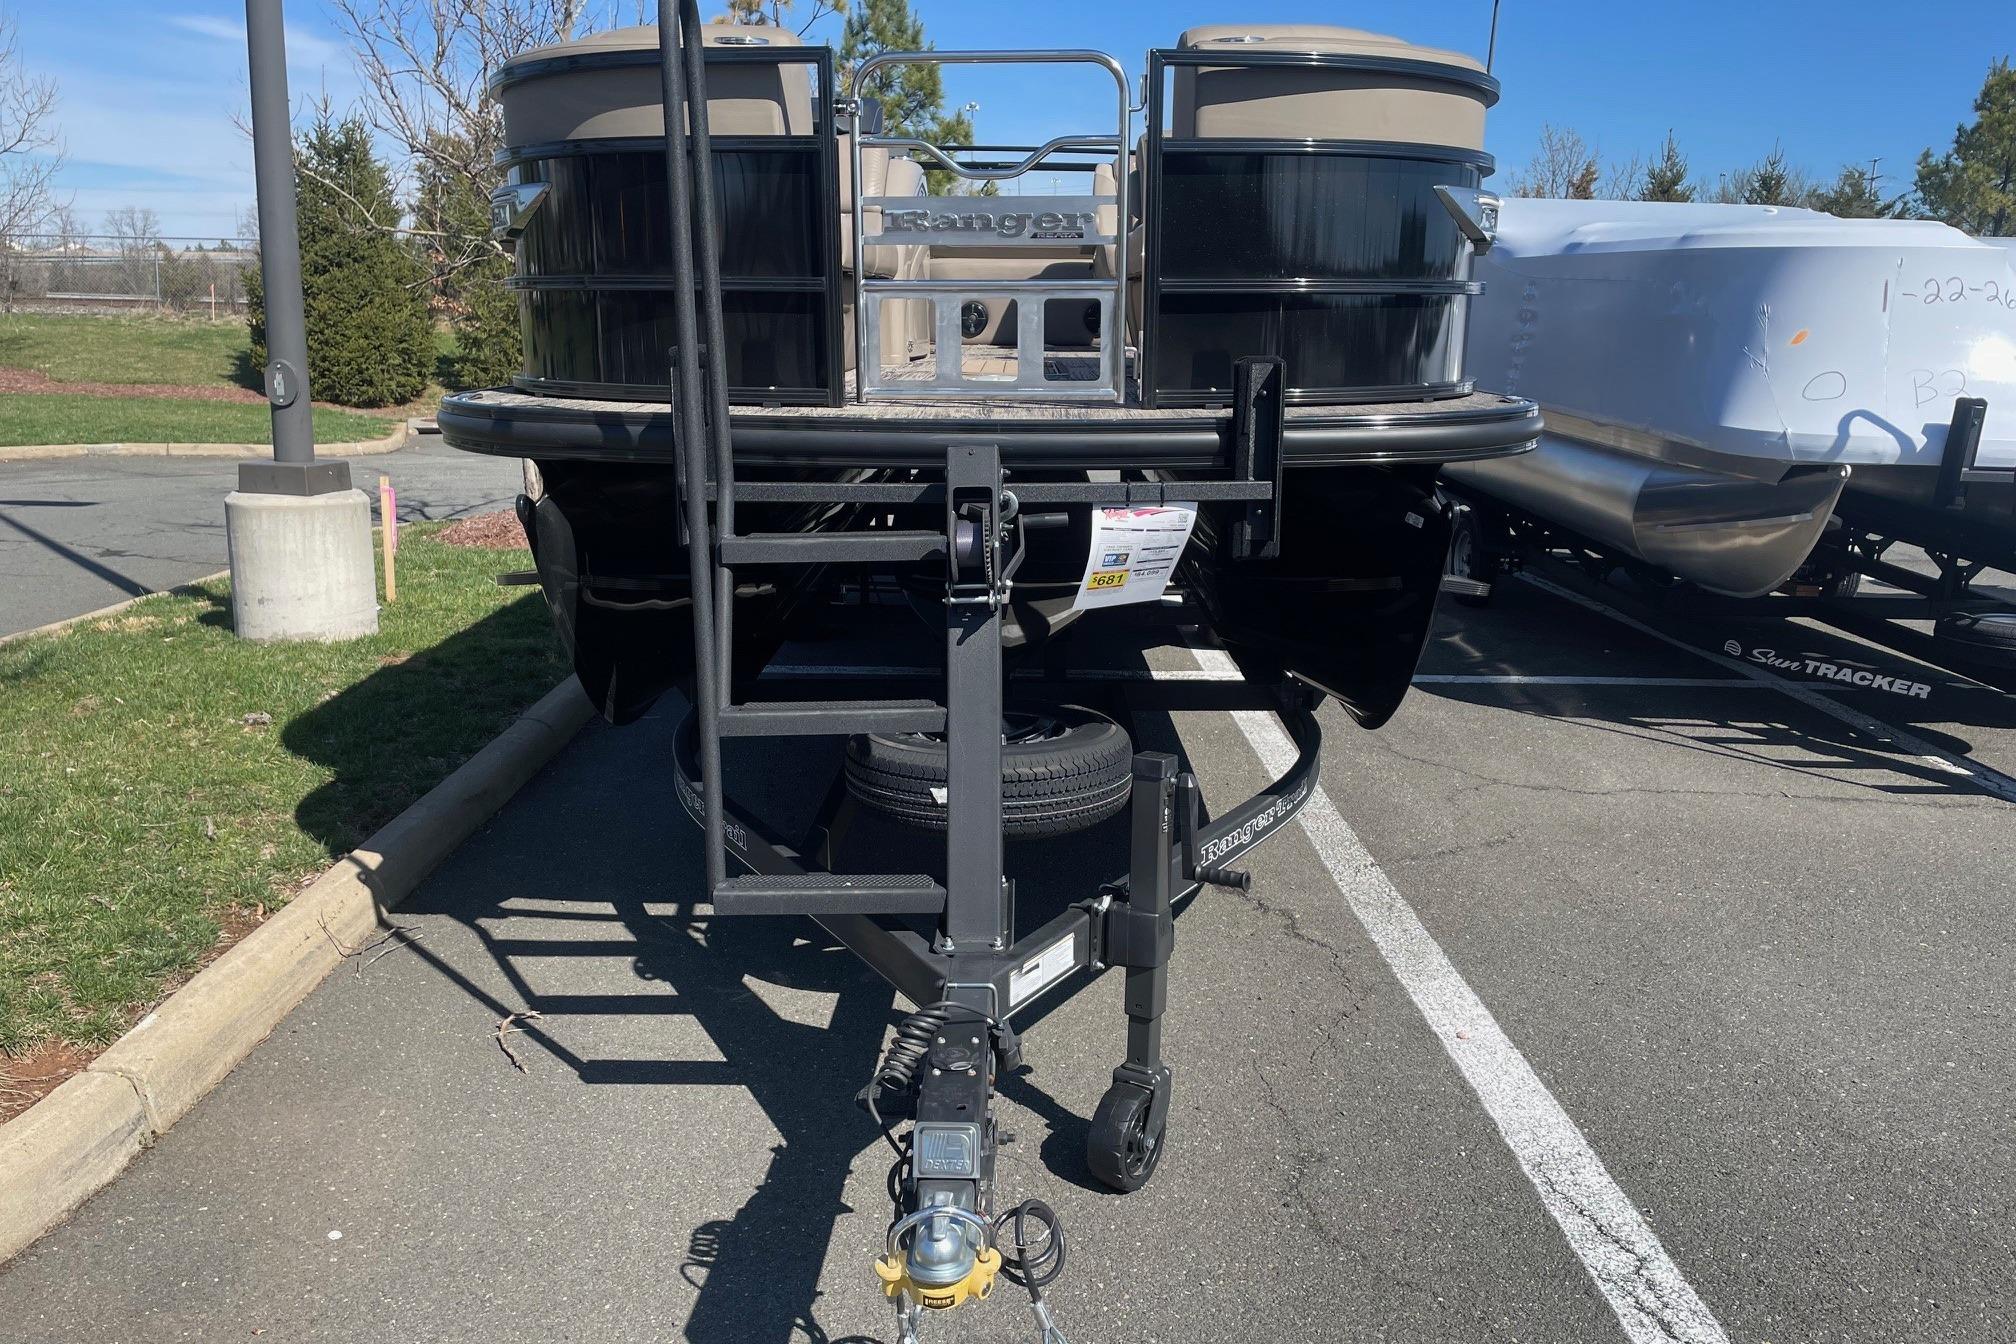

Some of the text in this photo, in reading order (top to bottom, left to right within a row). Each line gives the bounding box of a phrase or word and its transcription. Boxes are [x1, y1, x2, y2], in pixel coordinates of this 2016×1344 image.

[883, 209, 1096, 237] Ranger
[1092, 574, 1124, 586] $681
[1745, 648, 1932, 699] Sun TRACKER
[1200, 806, 1276, 867] Ranger
[924, 1159, 971, 1170] DEXTER
